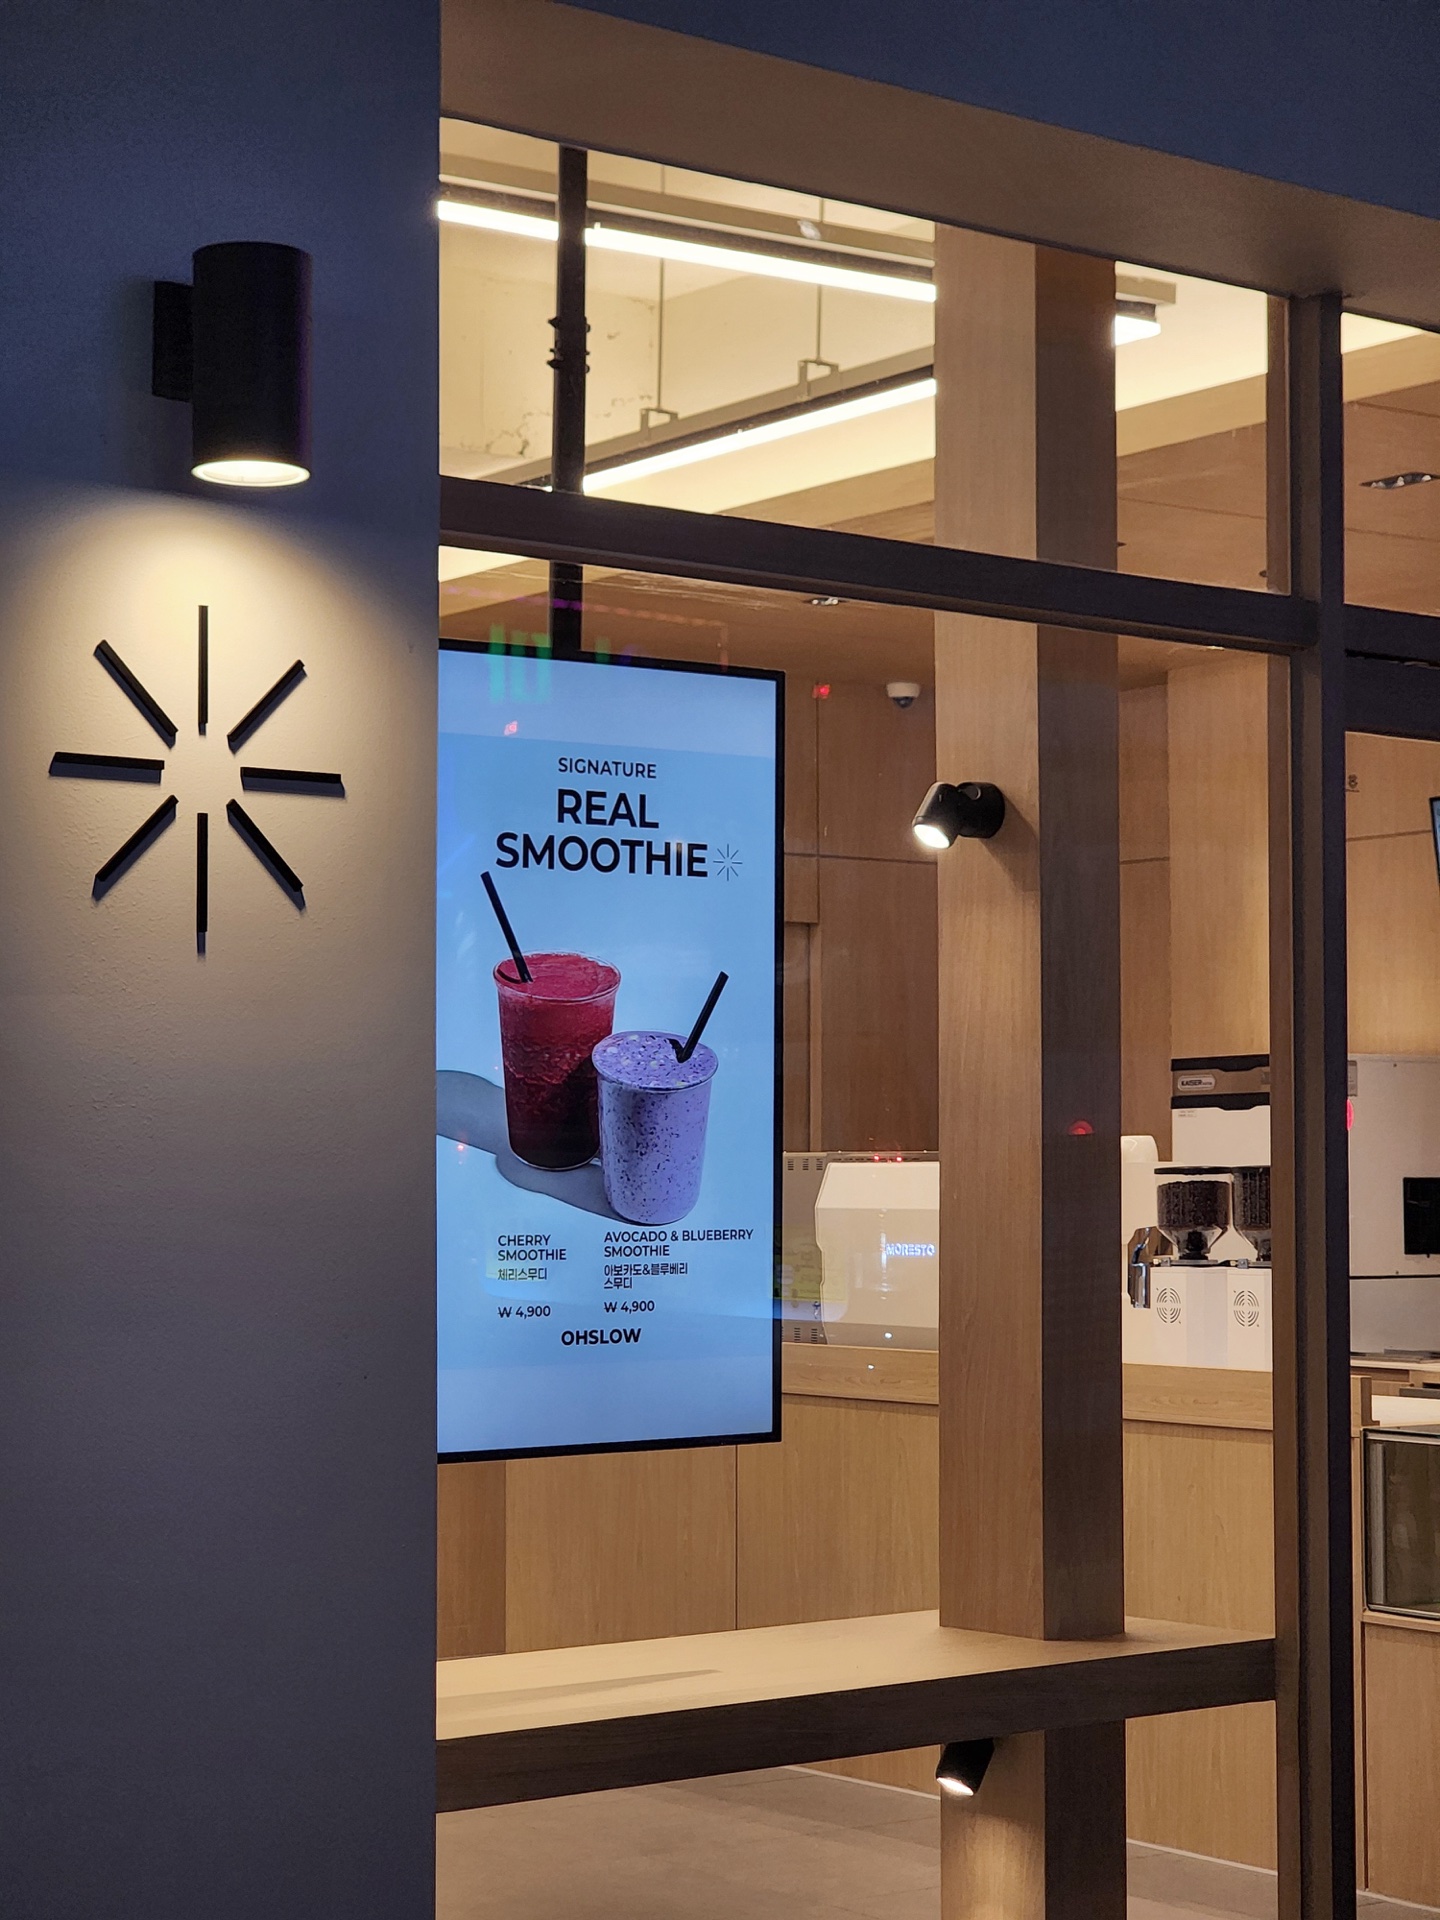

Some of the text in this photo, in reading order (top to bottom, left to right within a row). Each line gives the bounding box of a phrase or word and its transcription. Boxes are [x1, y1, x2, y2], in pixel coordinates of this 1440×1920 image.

[558, 757, 657, 779] SIGNATURE
[557, 788, 660, 829] REAL
[495, 831, 709, 878] SMOOTHIE
[497, 1234, 552, 1247] CHERRY
[603, 1228, 754, 1243] AVOCADO & BLUEBERRY
[497, 1248, 567, 1261] SMOOTHIE
[603, 1244, 670, 1258] SMOOTHIE
[497, 1267, 548, 1281] 체리스무디
[603, 1262, 688, 1277] 아보카도&블루베리
[603, 1276, 633, 1290] 스무디
[515, 1305, 551, 1320] 4,900
[620, 1300, 655, 1315] 4,900
[561, 1327, 642, 1346] OHSLOW
